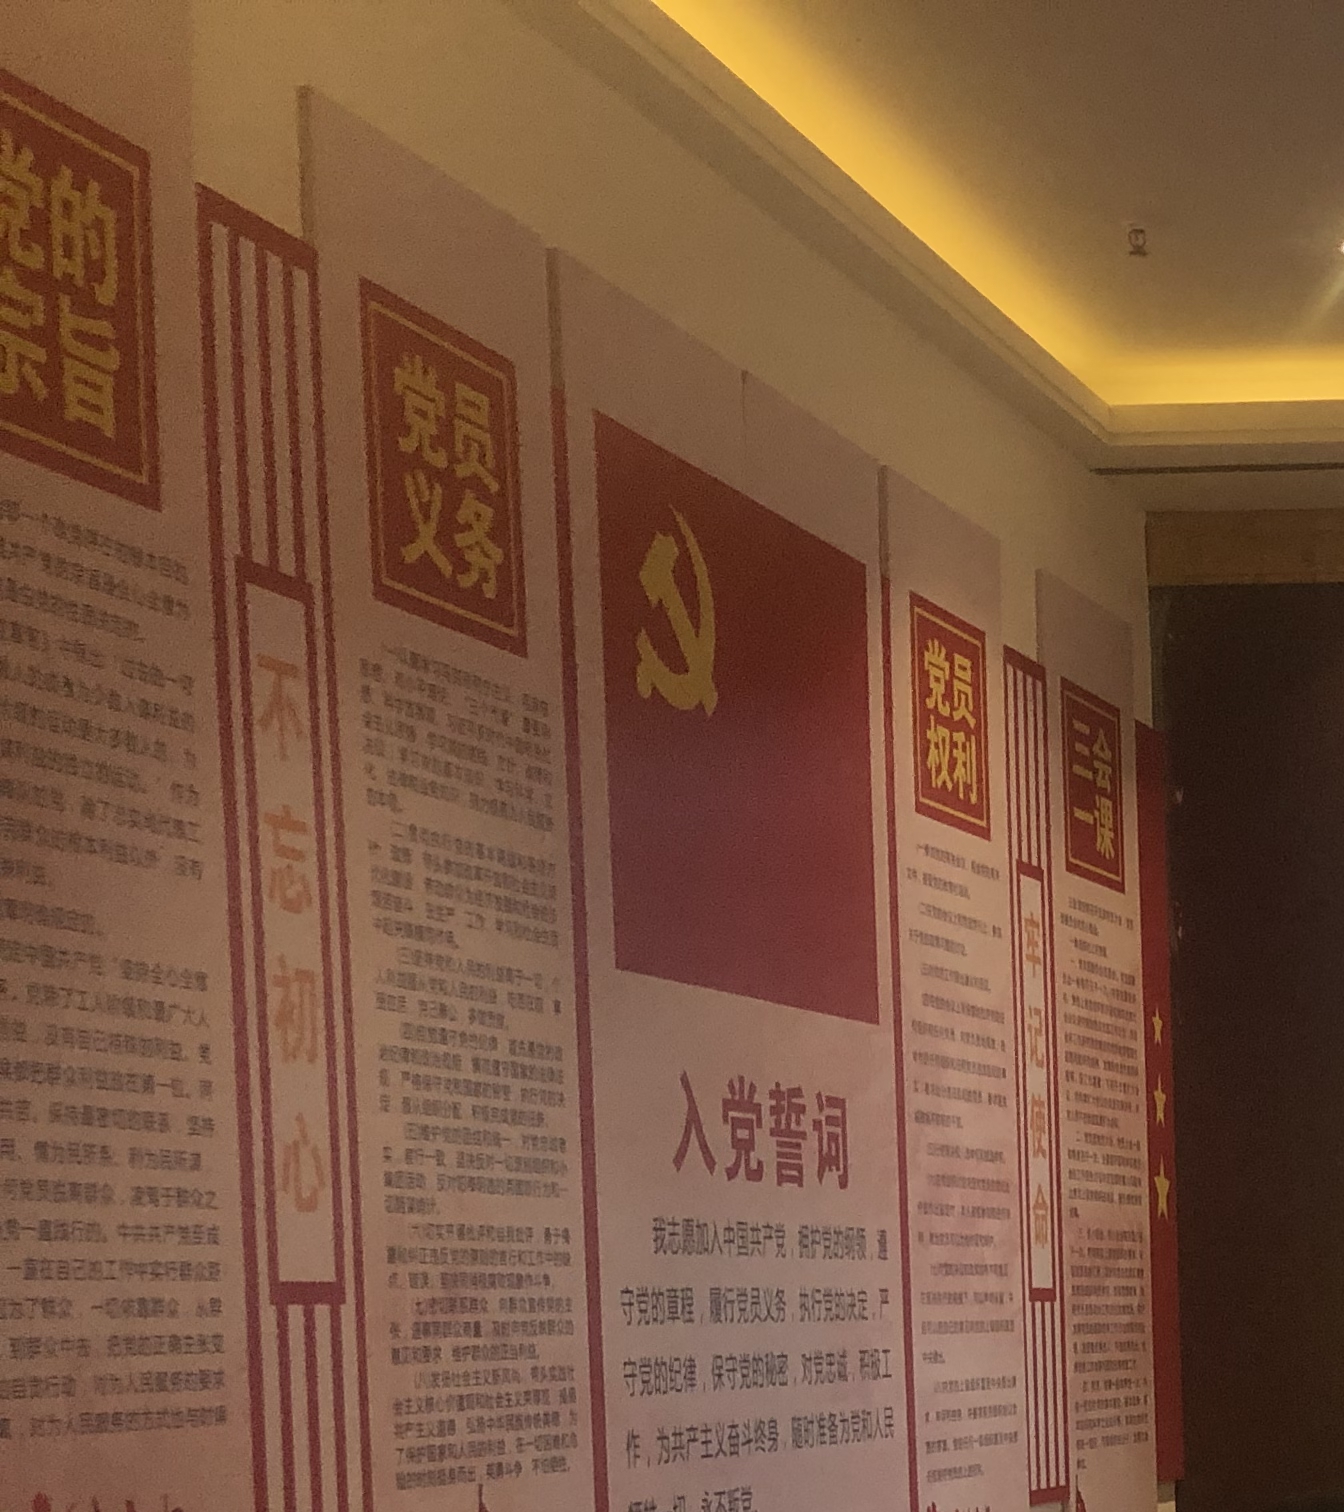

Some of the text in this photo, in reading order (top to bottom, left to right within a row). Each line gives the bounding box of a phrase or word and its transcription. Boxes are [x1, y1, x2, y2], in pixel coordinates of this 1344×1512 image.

[394, 353, 500, 494] 党员
[399, 469, 504, 600] 义务
[924, 637, 976, 730] 党员
[926, 714, 978, 805] 权利
[1072, 716, 1113, 795] 三会
[1073, 793, 1115, 860] 一课
[256, 652, 325, 1215] 不忘初心
[672, 1069, 850, 1191] 入党誓词
[1023, 911, 1048, 1250] 牢记使命
